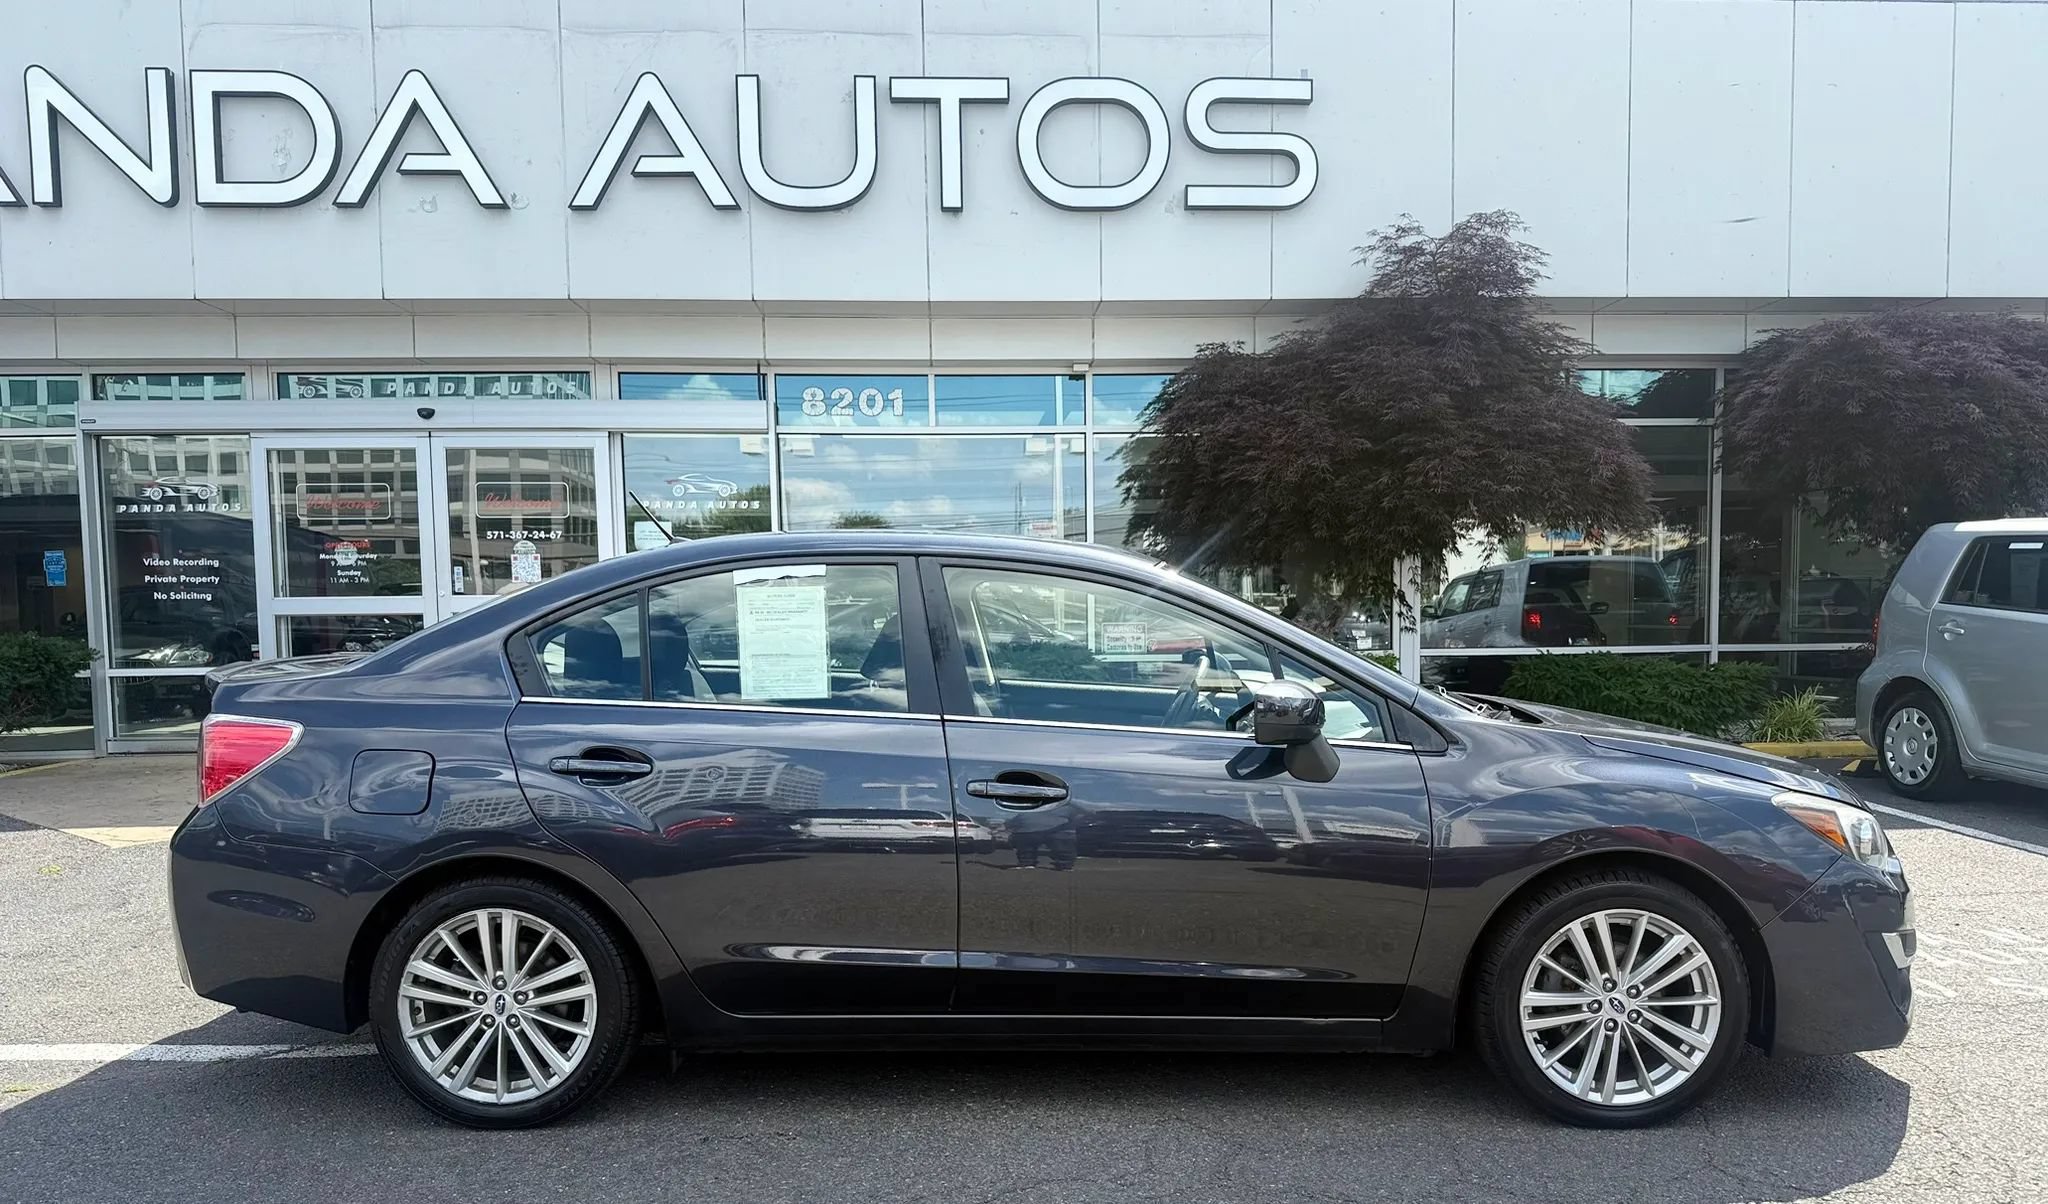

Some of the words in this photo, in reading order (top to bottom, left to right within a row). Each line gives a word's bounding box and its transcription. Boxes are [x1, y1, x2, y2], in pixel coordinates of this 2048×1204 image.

[0, 63, 511, 209] NDA
[571, 71, 1319, 211] AUTOS
[385, 382, 474, 395] PANDA
[801, 386, 904, 417] 8201
[117, 504, 177, 513] PANDA
[185, 503, 242, 513] AUTOS
[642, 500, 697, 510] PANDA
[707, 500, 760, 510] AUTOS
[486, 530, 563, 540] 571-367-24-67
[143, 558, 170, 567] Video
[173, 558, 219, 568] Recording
[337, 569, 361, 577] Sunday
[144, 575, 177, 583] Private
[180, 575, 220, 585] Property
[153, 592, 168, 600] No
[169, 592, 212, 601] Soliciting
